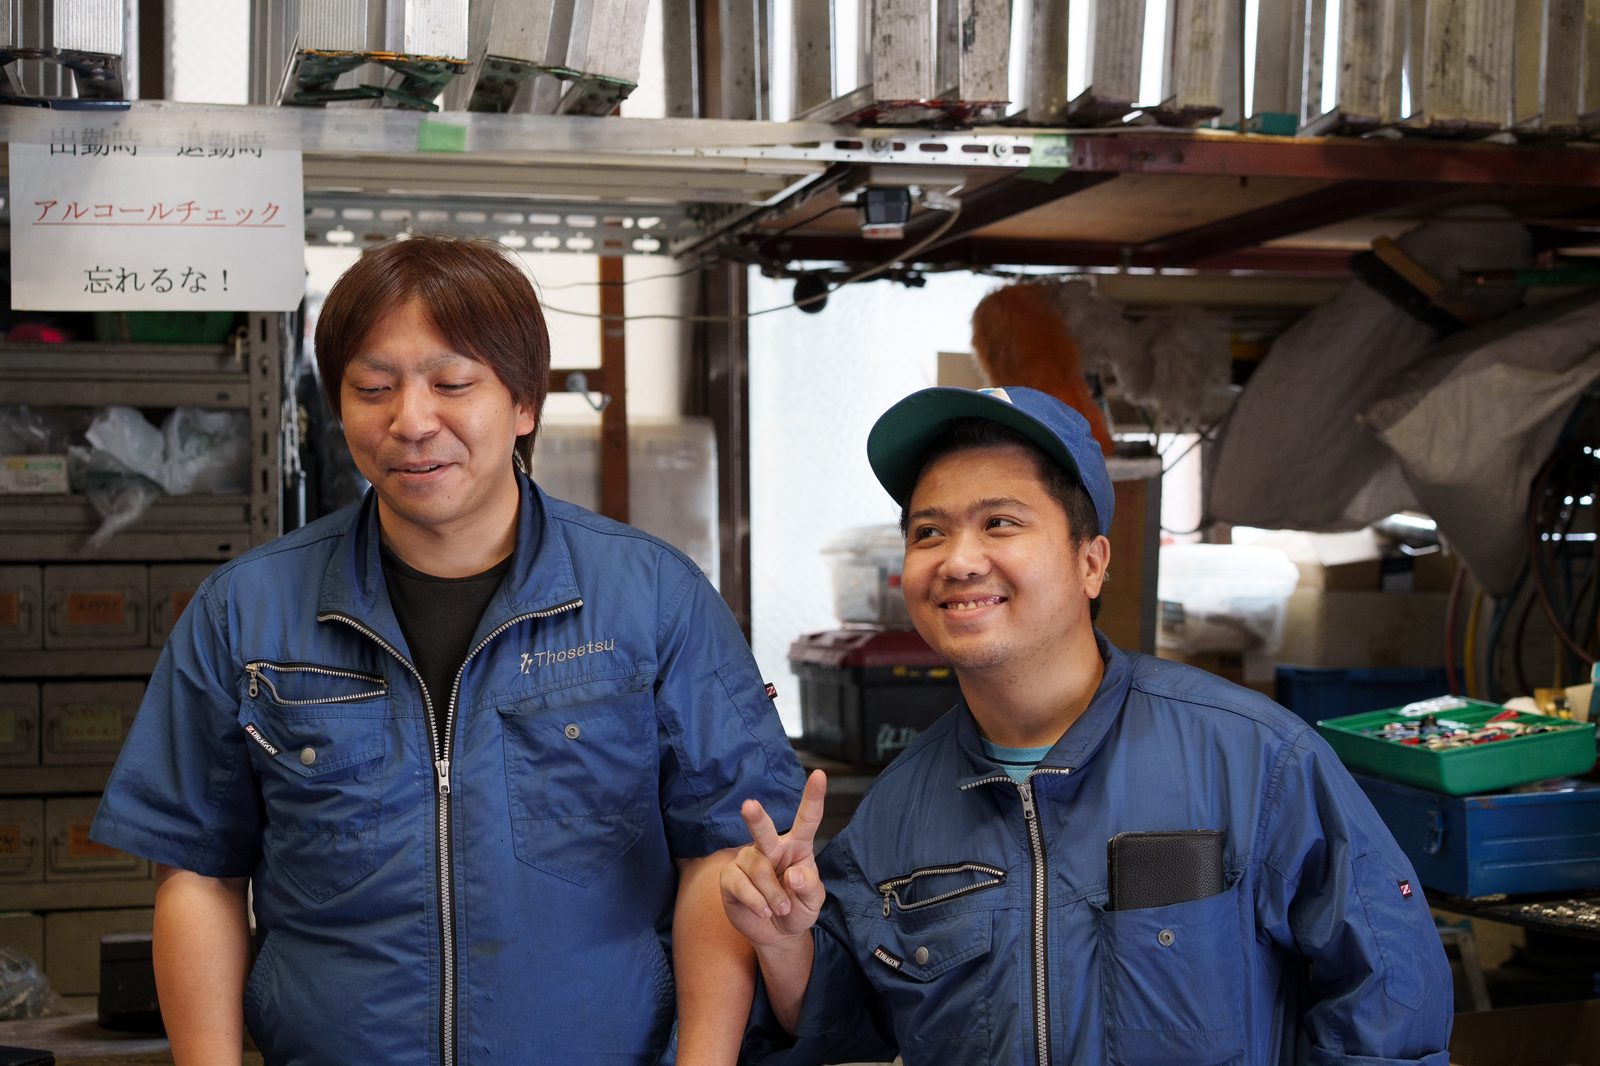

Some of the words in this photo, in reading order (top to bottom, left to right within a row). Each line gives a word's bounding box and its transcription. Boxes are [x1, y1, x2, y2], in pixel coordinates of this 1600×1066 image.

[34, 200, 280, 225] アルコールチェック
[83, 265, 229, 293] 忘れるな！
[535, 638, 614, 667] Thosetsu
